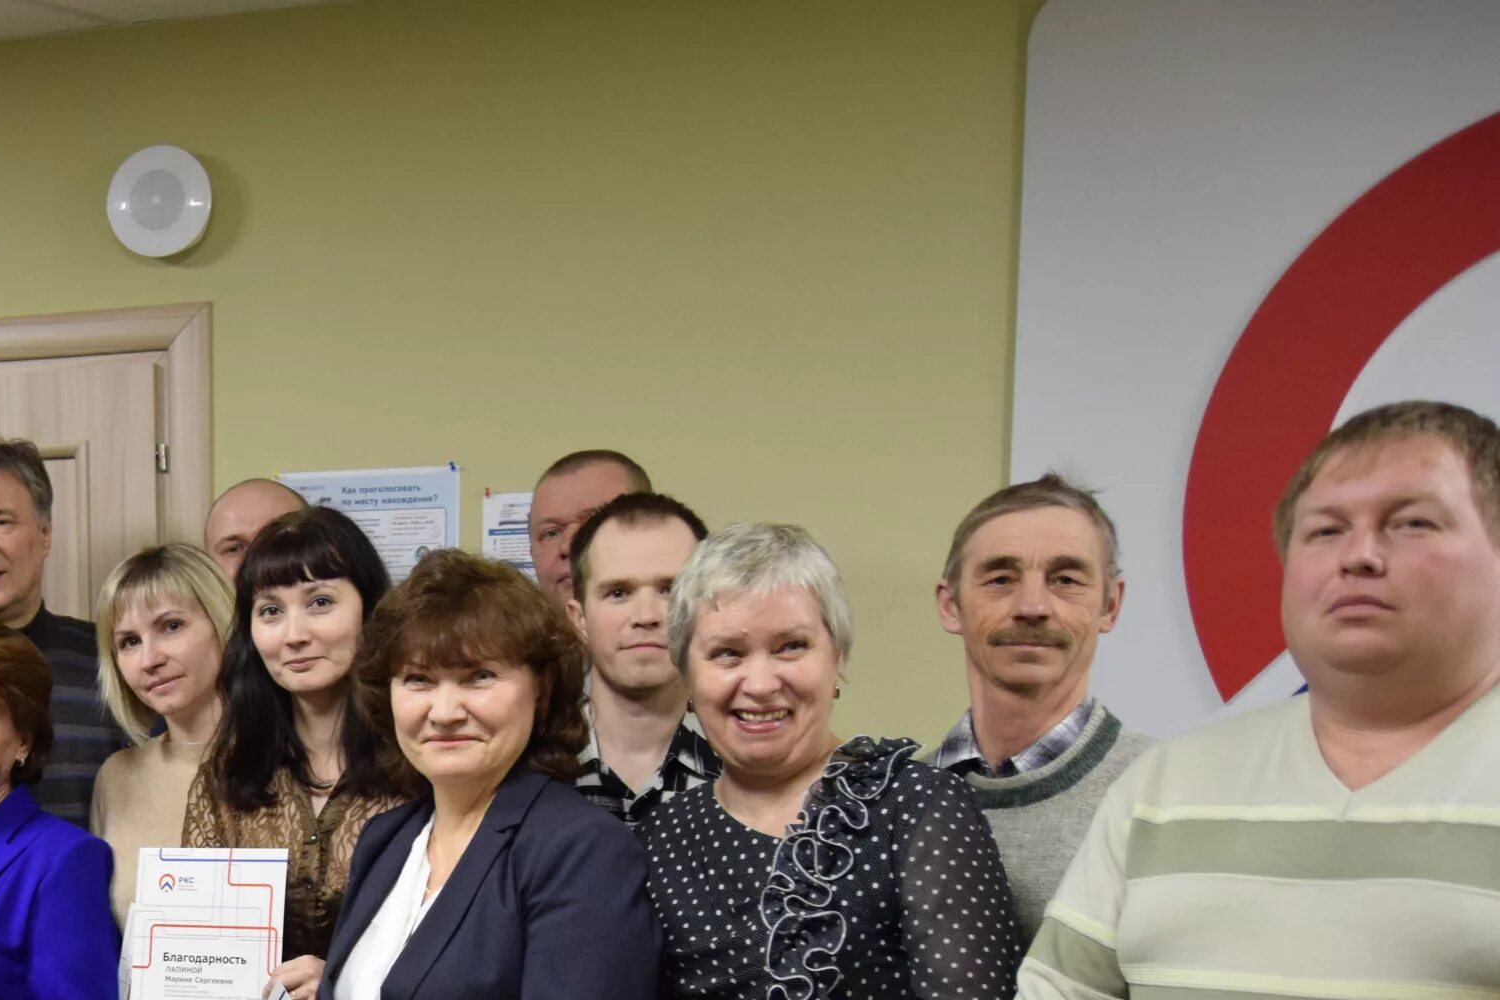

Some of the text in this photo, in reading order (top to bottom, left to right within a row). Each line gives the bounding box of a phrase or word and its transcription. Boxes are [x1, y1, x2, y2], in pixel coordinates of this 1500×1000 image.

[341, 484, 421, 497] Как проголосовать
[163, 952, 247, 966] Благодарность
[165, 965, 203, 974] ЛАПИНОЙ
[165, 975, 234, 985] Марине Сергеевне
